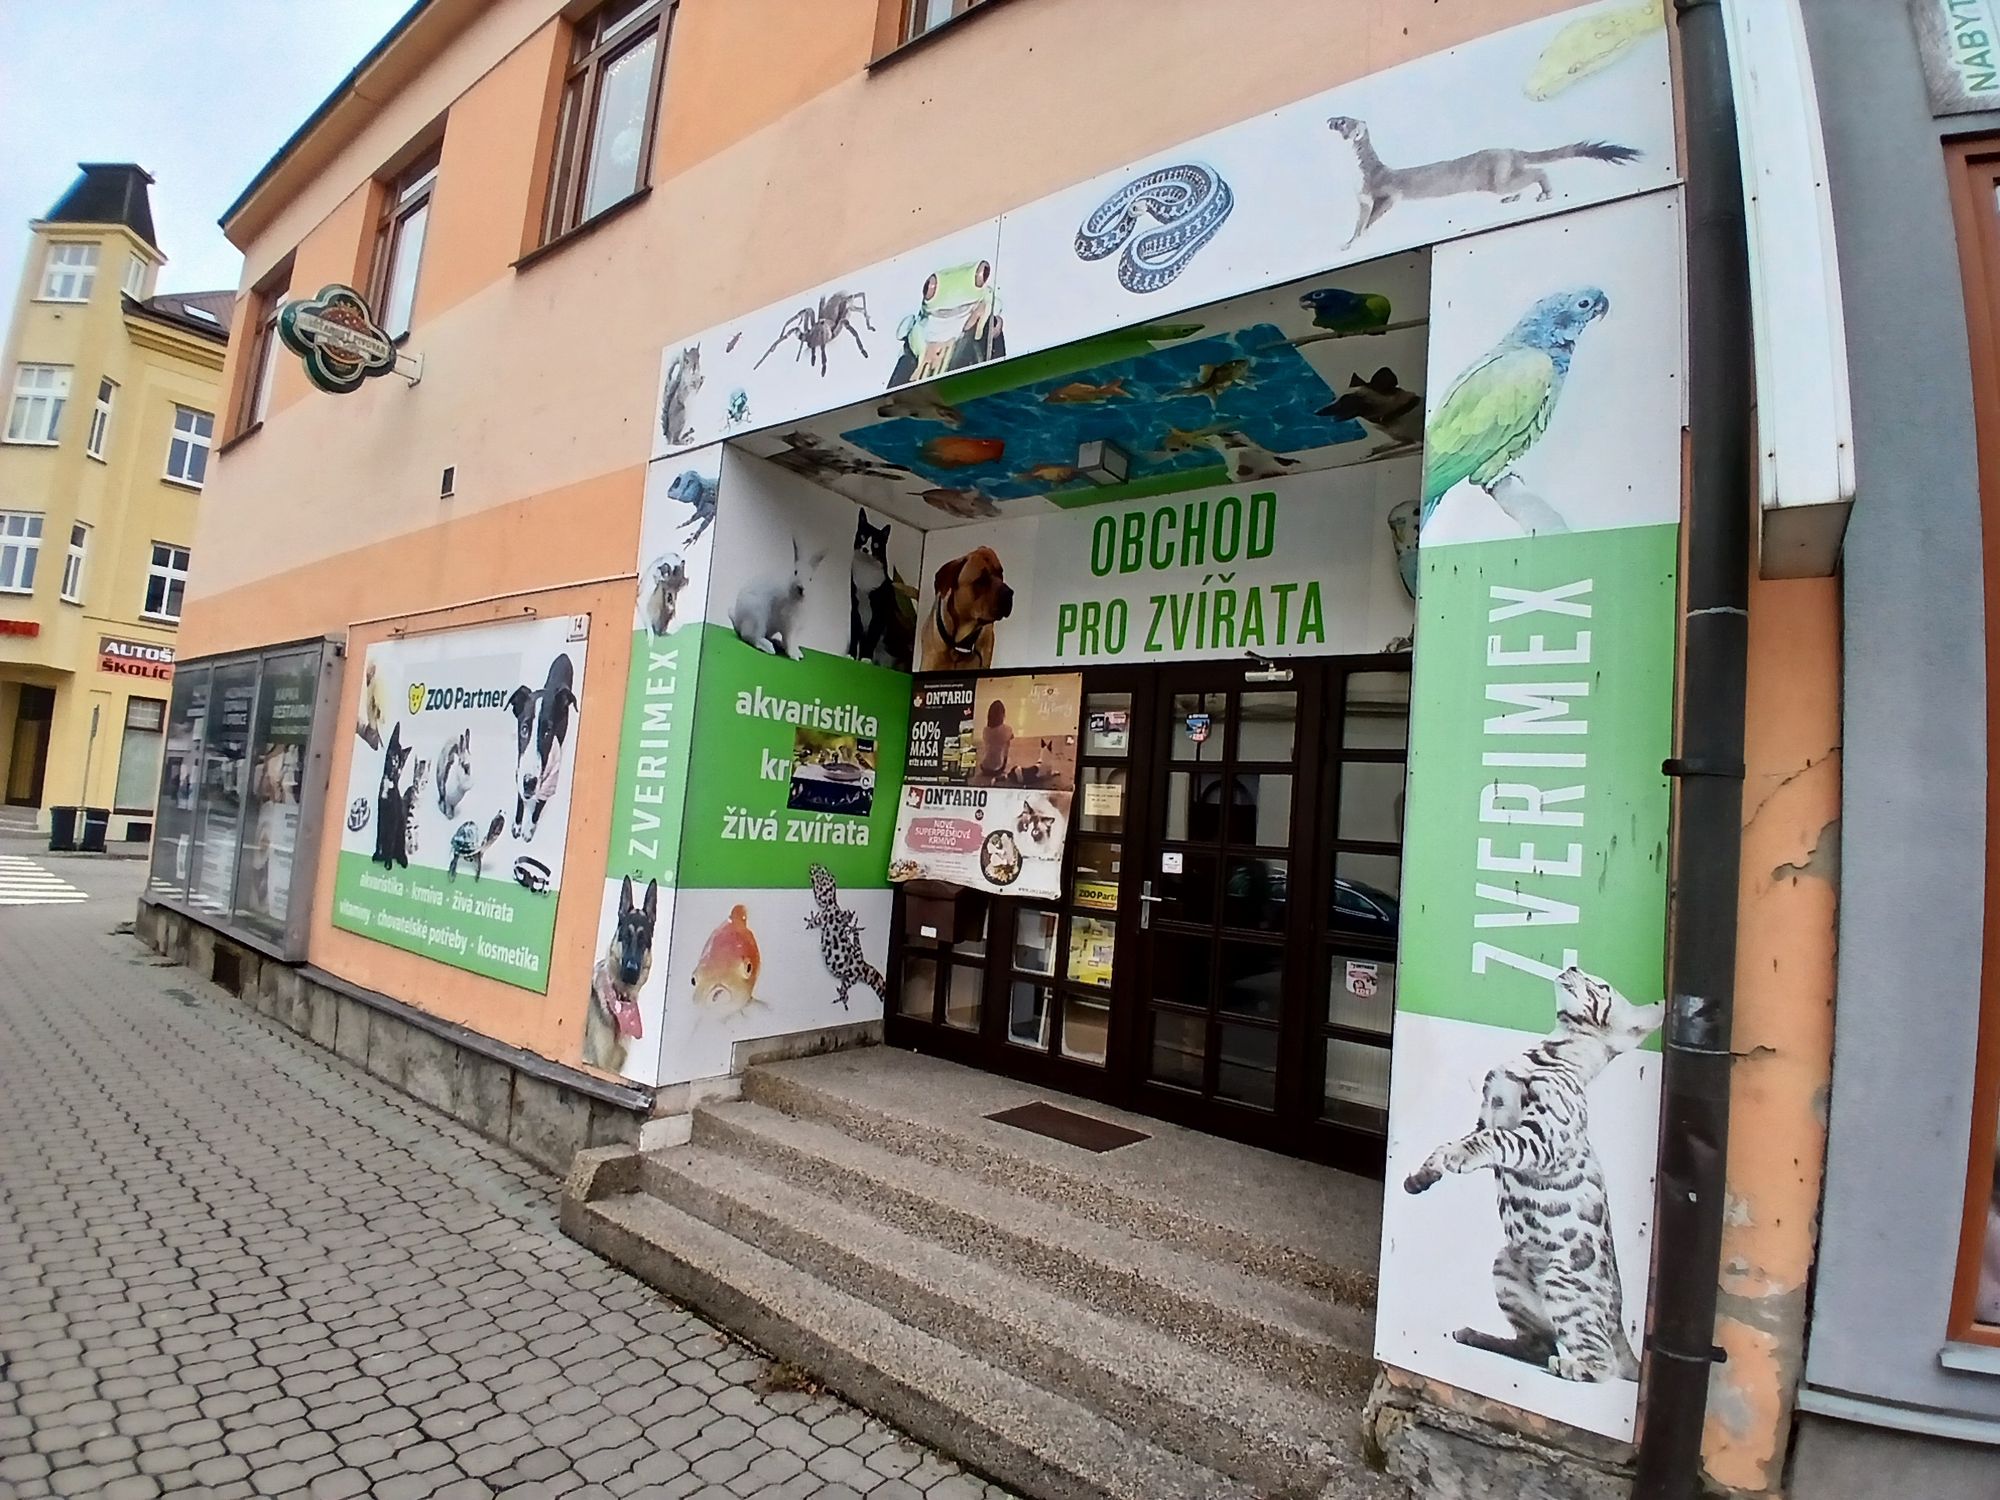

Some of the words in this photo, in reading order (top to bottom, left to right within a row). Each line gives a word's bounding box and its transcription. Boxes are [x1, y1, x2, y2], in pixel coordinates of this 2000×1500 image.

[1091, 491, 1277, 577] OBCHOD
[1056, 598, 1128, 657] PRO
[1144, 572, 1325, 652] ZVÍŘATA
[104, 641, 175, 662] AUTOŠ
[425, 687, 454, 712] ZOO
[454, 685, 508, 710] Partner
[735, 686, 878, 738] akvaristika
[925, 690, 973, 705] ONTARIO
[909, 741, 938, 757] MASA
[911, 721, 941, 740] 60%
[628, 649, 679, 860] ZVERIMEX
[760, 748, 793, 782] kr
[924, 788, 988, 808] ONTARIO
[1471, 578, 1593, 981] ZVERIMEX
[720, 806, 778, 842] živá
[785, 812, 870, 847] zvířata
[360, 871, 403, 896] akvaristika
[412, 881, 443, 906] krmiva
[452, 890, 473, 914] živá
[475, 896, 514, 923] zvířata
[377, 908, 427, 939] chovatelské
[429, 925, 468, 955] potřeby
[477, 935, 540, 971] kosmetika
